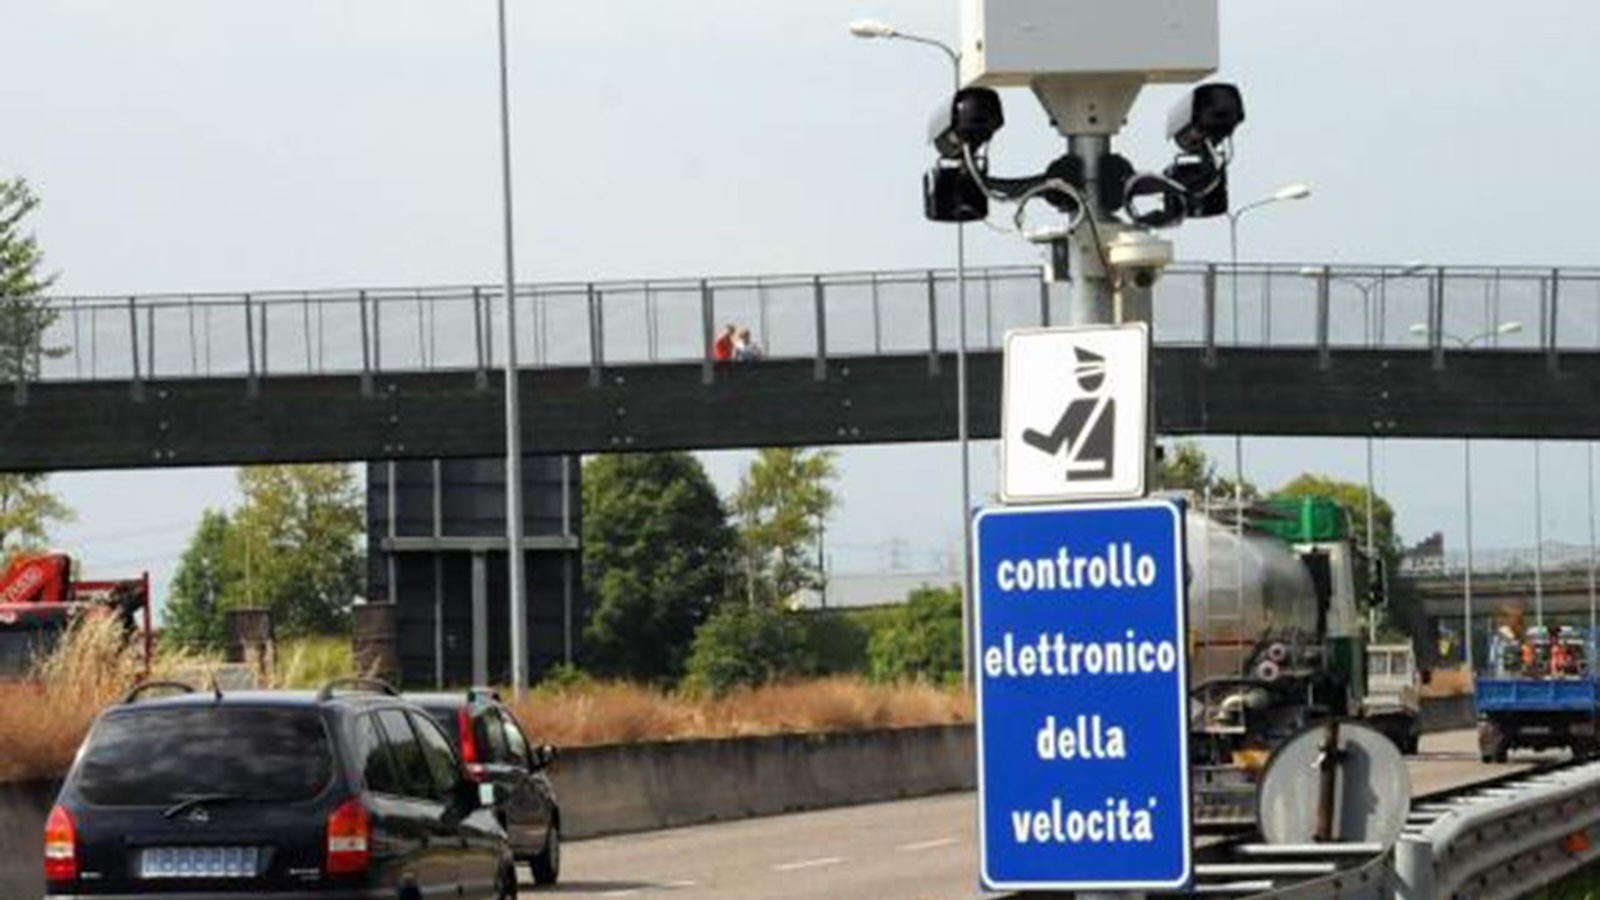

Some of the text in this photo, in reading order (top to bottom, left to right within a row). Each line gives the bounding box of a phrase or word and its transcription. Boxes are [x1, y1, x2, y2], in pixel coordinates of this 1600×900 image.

[997, 543, 1156, 591] controllo
[984, 630, 1176, 678] elettronico
[1036, 715, 1126, 760] della
